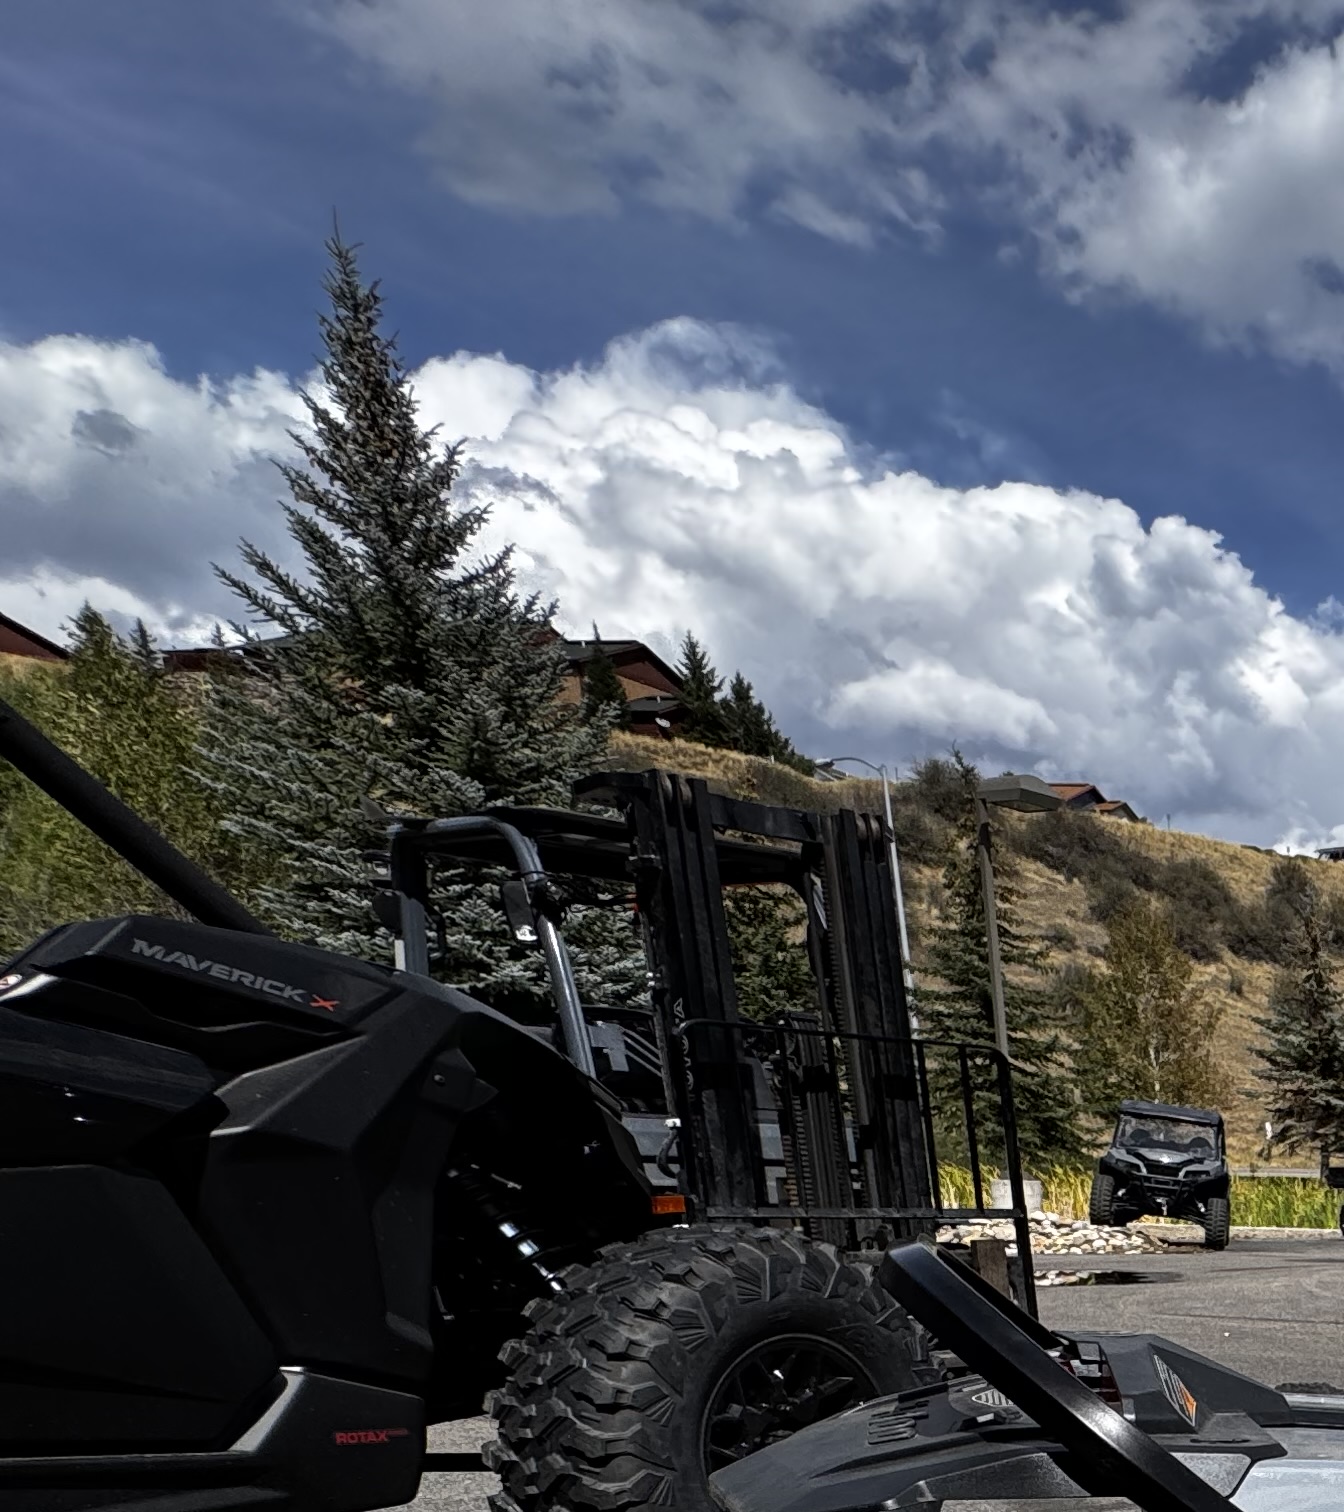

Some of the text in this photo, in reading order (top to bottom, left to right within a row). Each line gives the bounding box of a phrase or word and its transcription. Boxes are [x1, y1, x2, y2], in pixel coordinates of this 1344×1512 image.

[131, 938, 341, 1012] MAVERICK X
[335, 1431, 388, 1445] ROTAX
